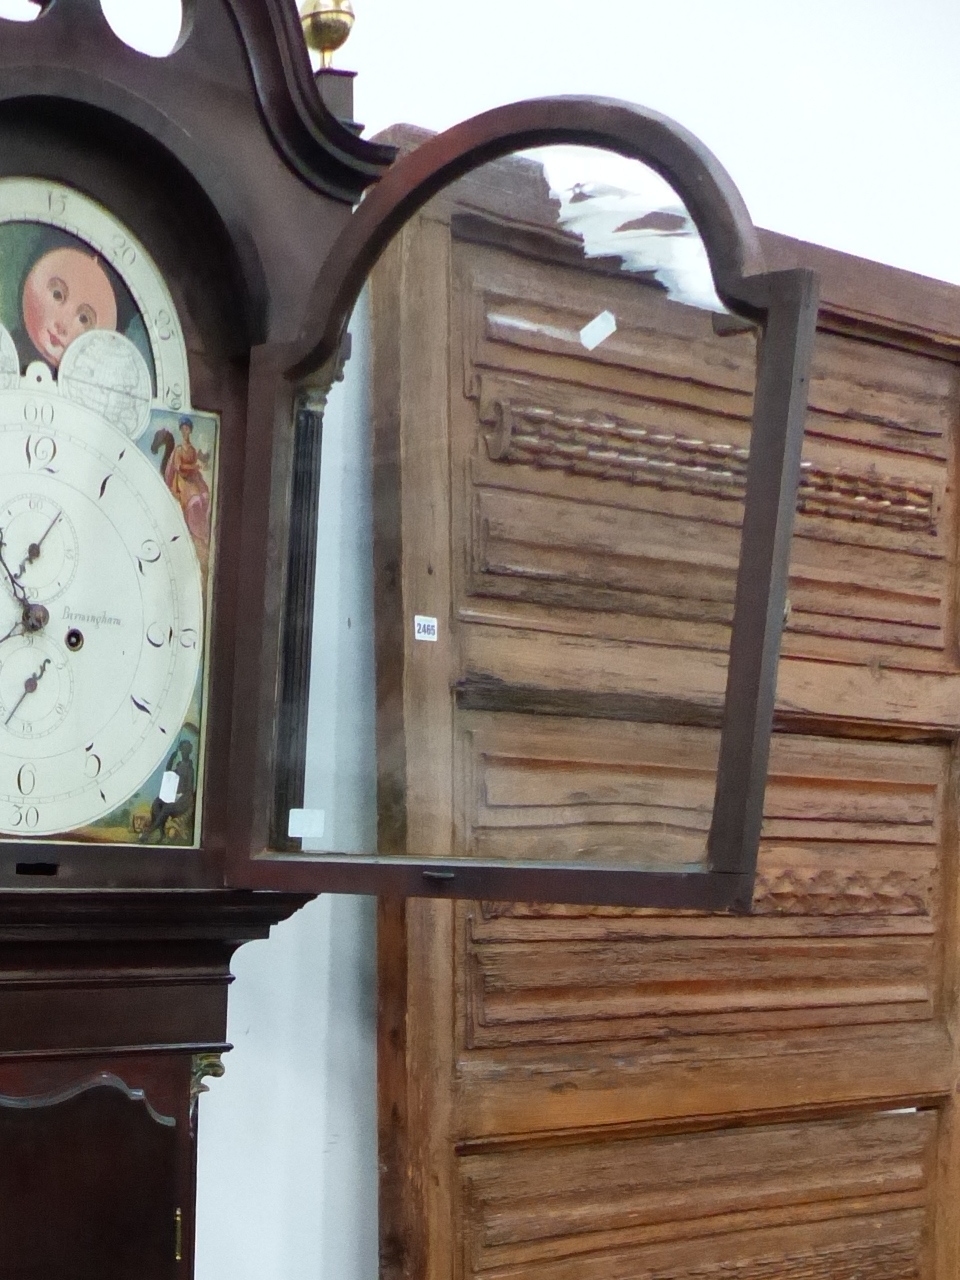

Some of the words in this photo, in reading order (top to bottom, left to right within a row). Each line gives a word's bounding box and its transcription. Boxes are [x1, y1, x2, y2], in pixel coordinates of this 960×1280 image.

[47, 190, 68, 217] 15
[112, 234, 137, 266] 20
[23, 401, 55, 426] 60
[25, 434, 60, 474] 12
[98, 473, 113, 500] 1
[135, 538, 162, 577] 2
[146, 621, 172, 648] 3
[416, 622, 436, 636] 2465
[83, 742, 102, 779] 5
[17, 762, 36, 796] 6
[9, 804, 39, 828] 30
